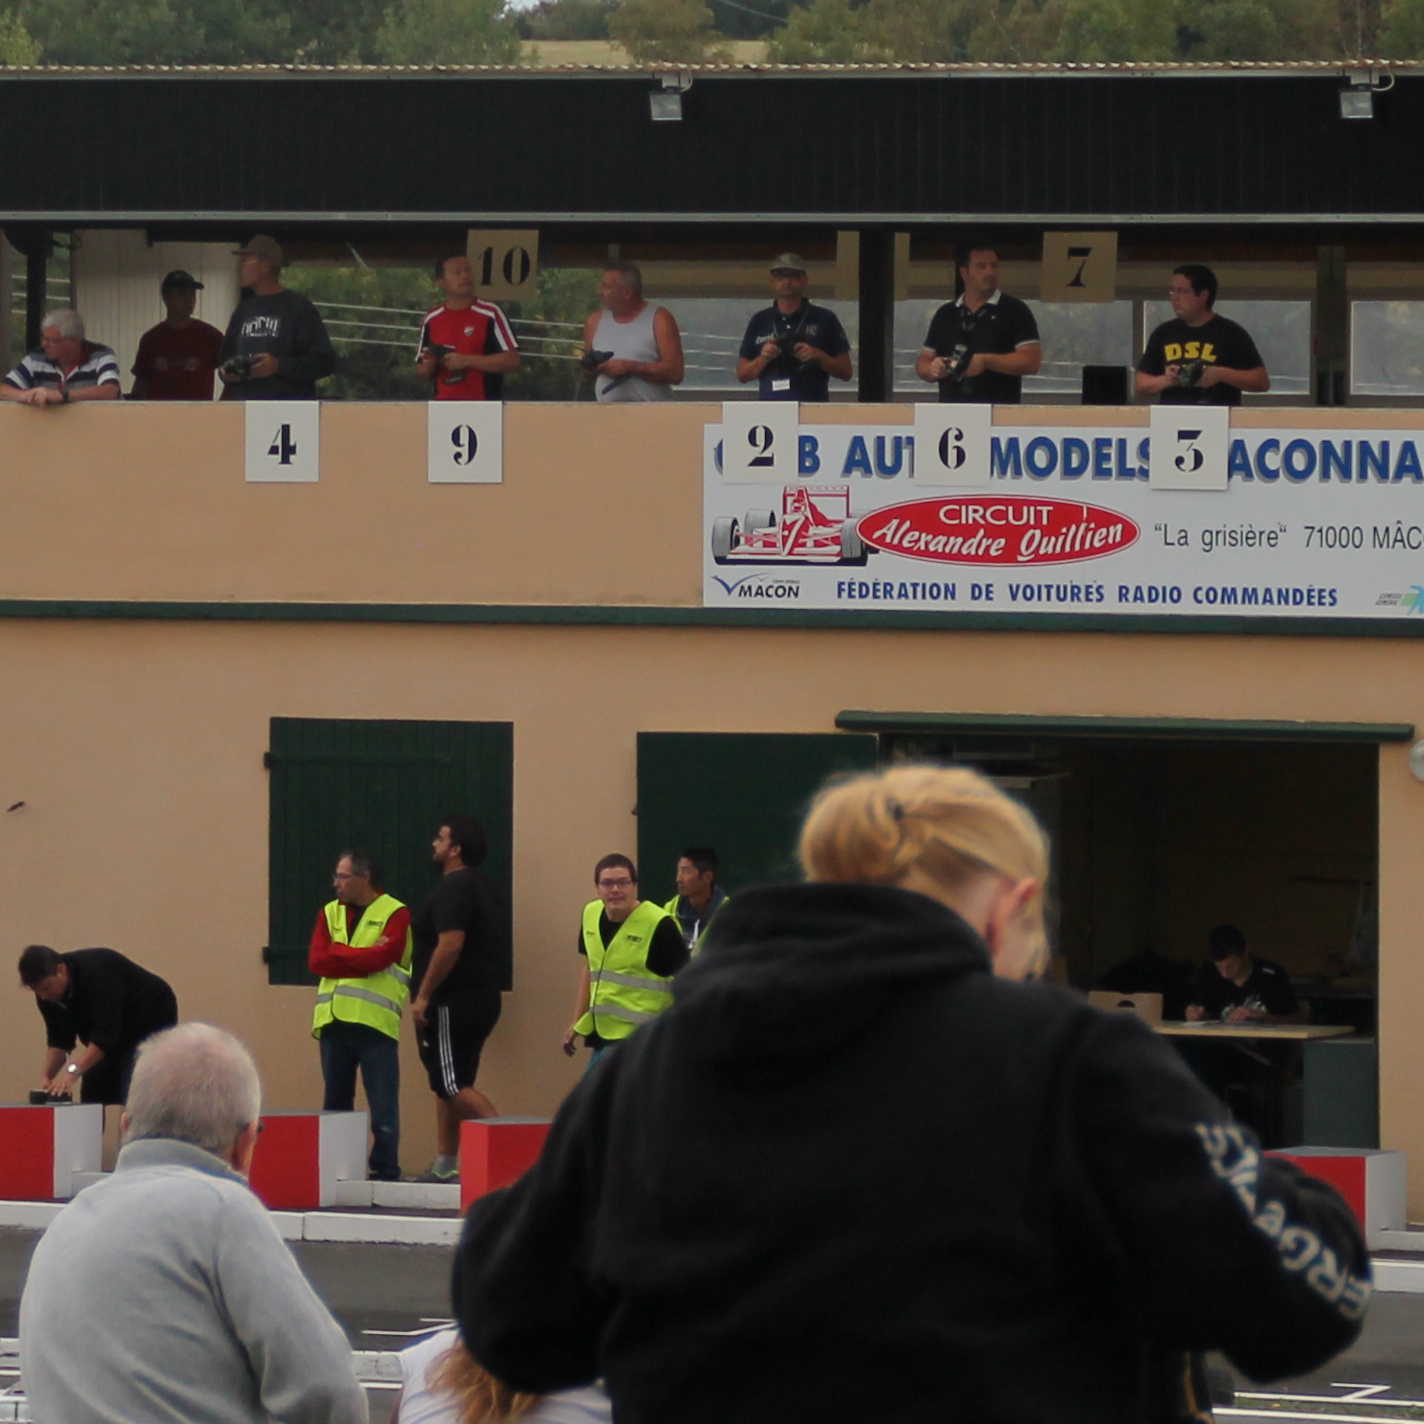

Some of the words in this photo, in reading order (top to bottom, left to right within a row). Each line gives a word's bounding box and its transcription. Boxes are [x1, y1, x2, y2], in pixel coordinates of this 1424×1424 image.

[479, 247, 530, 286] 10
[1066, 247, 1092, 287] 7
[1164, 341, 1217, 363] DSL
[267, 424, 297, 465] 4
[451, 424, 478, 465] 9
[747, 425, 775, 467] 2
[938, 427, 967, 469] 6
[1174, 429, 1204, 472] 3
[939, 505, 1053, 525] CIRCUIT
[872, 518, 1006, 557] Alexandre
[1304, 526, 1363, 548] 71000
[738, 584, 800, 599] MACON
[970, 582, 994, 601] DE
[1009, 583, 1104, 603] VOITURES
[1118, 585, 1181, 604] RADIO
[1192, 584, 1338, 607] COMMANDÉES
